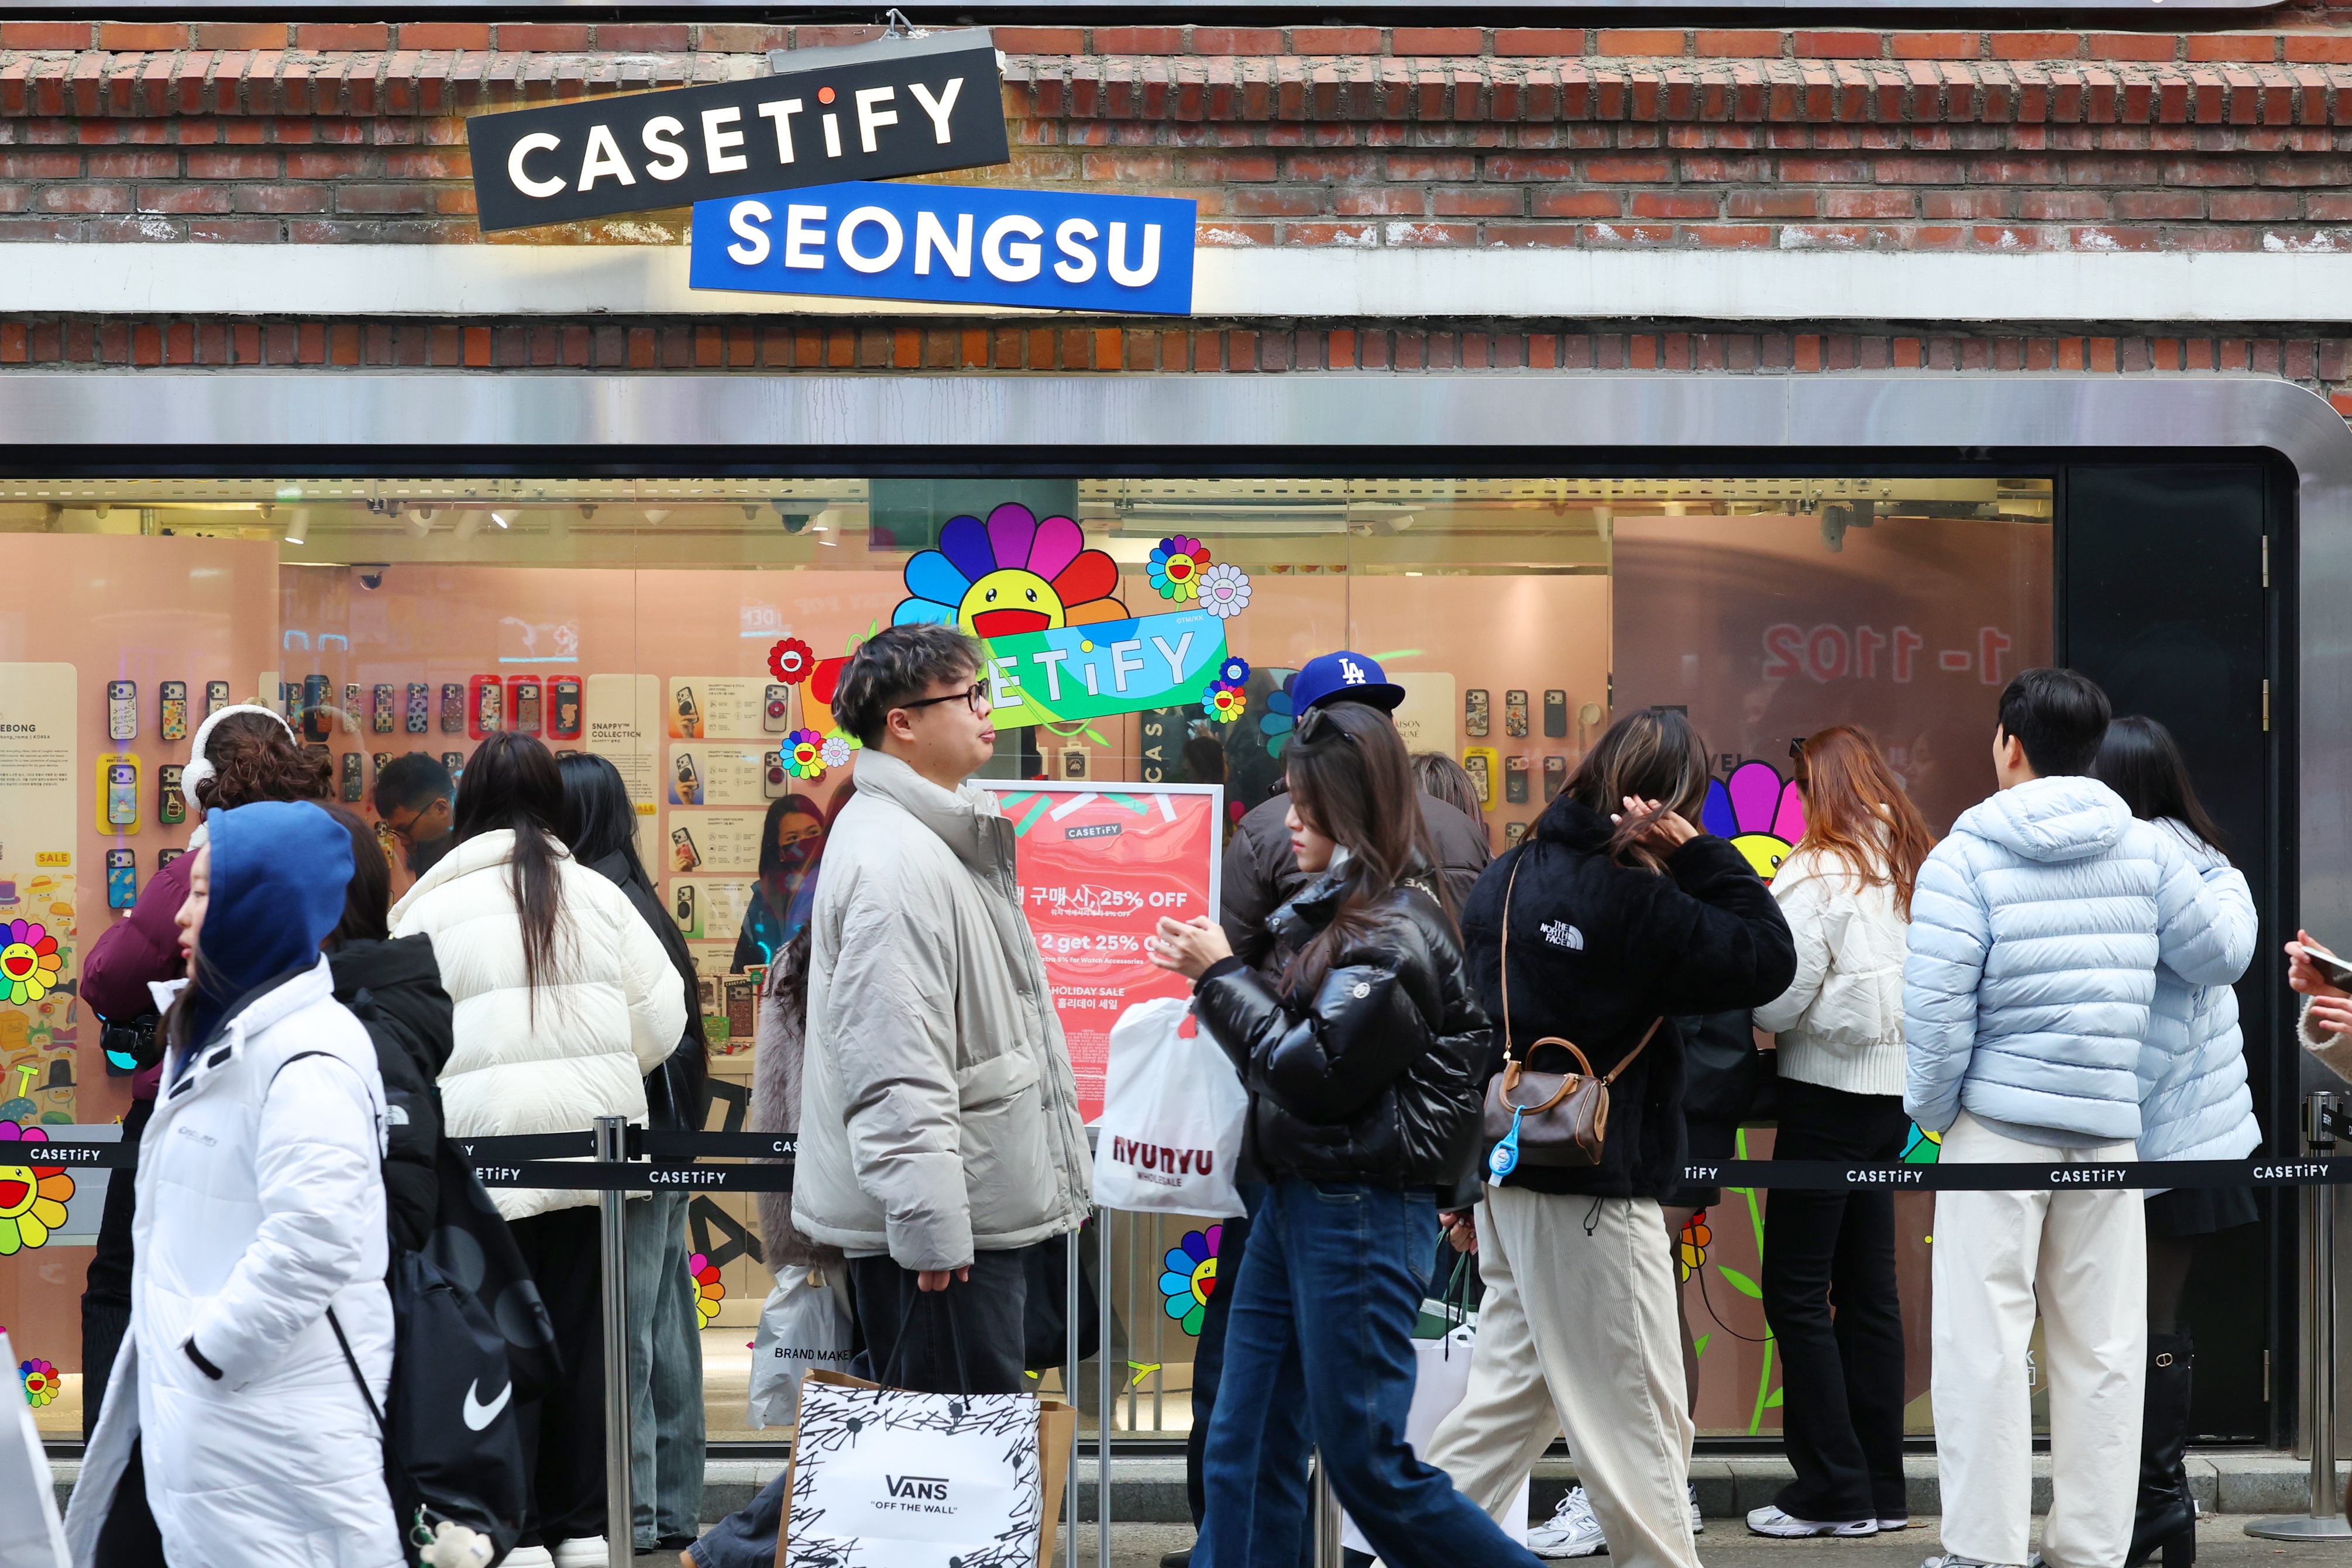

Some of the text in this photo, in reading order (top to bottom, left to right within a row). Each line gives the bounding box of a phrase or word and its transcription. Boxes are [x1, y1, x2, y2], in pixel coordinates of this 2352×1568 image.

[507, 78, 964, 198] CASETiFY
[726, 200, 1161, 288] SEONGSU
[991, 631, 1195, 709] ETiFY
[1339, 658, 1366, 685] LA
[1069, 826, 1118, 838] CASETiFY
[39, 854, 68, 862] SALE
[1030, 886, 1066, 906] 구매
[1101, 890, 1143, 907] 25%
[1149, 892, 1188, 907] OFF
[1540, 923, 1569, 940] NORTH
[1554, 919, 1569, 931] THE
[1041, 934, 1053, 949] 2
[1057, 935, 1091, 953] get
[1095, 936, 1139, 951] 25%
[1545, 933, 1567, 946] FACE
[1051, 986, 1125, 996] HOLIDAY SALE
[1057, 998, 1117, 1010] 홀리데이 세일
[30, 1148, 101, 1161] CASETiFY
[476, 1167, 520, 1181] ETiFY
[649, 1171, 726, 1184] CASETiFY
[1684, 1165, 1718, 1180] TiFY
[1846, 1170, 1923, 1184] CASETiFY
[2050, 1168, 2127, 1183] CASETiFY
[2253, 1164, 2329, 1180] CASETiFY
[775, 1347, 814, 1360] BRAND
[885, 1474, 949, 1501] VANS
[900, 1503, 921, 1512] THE
